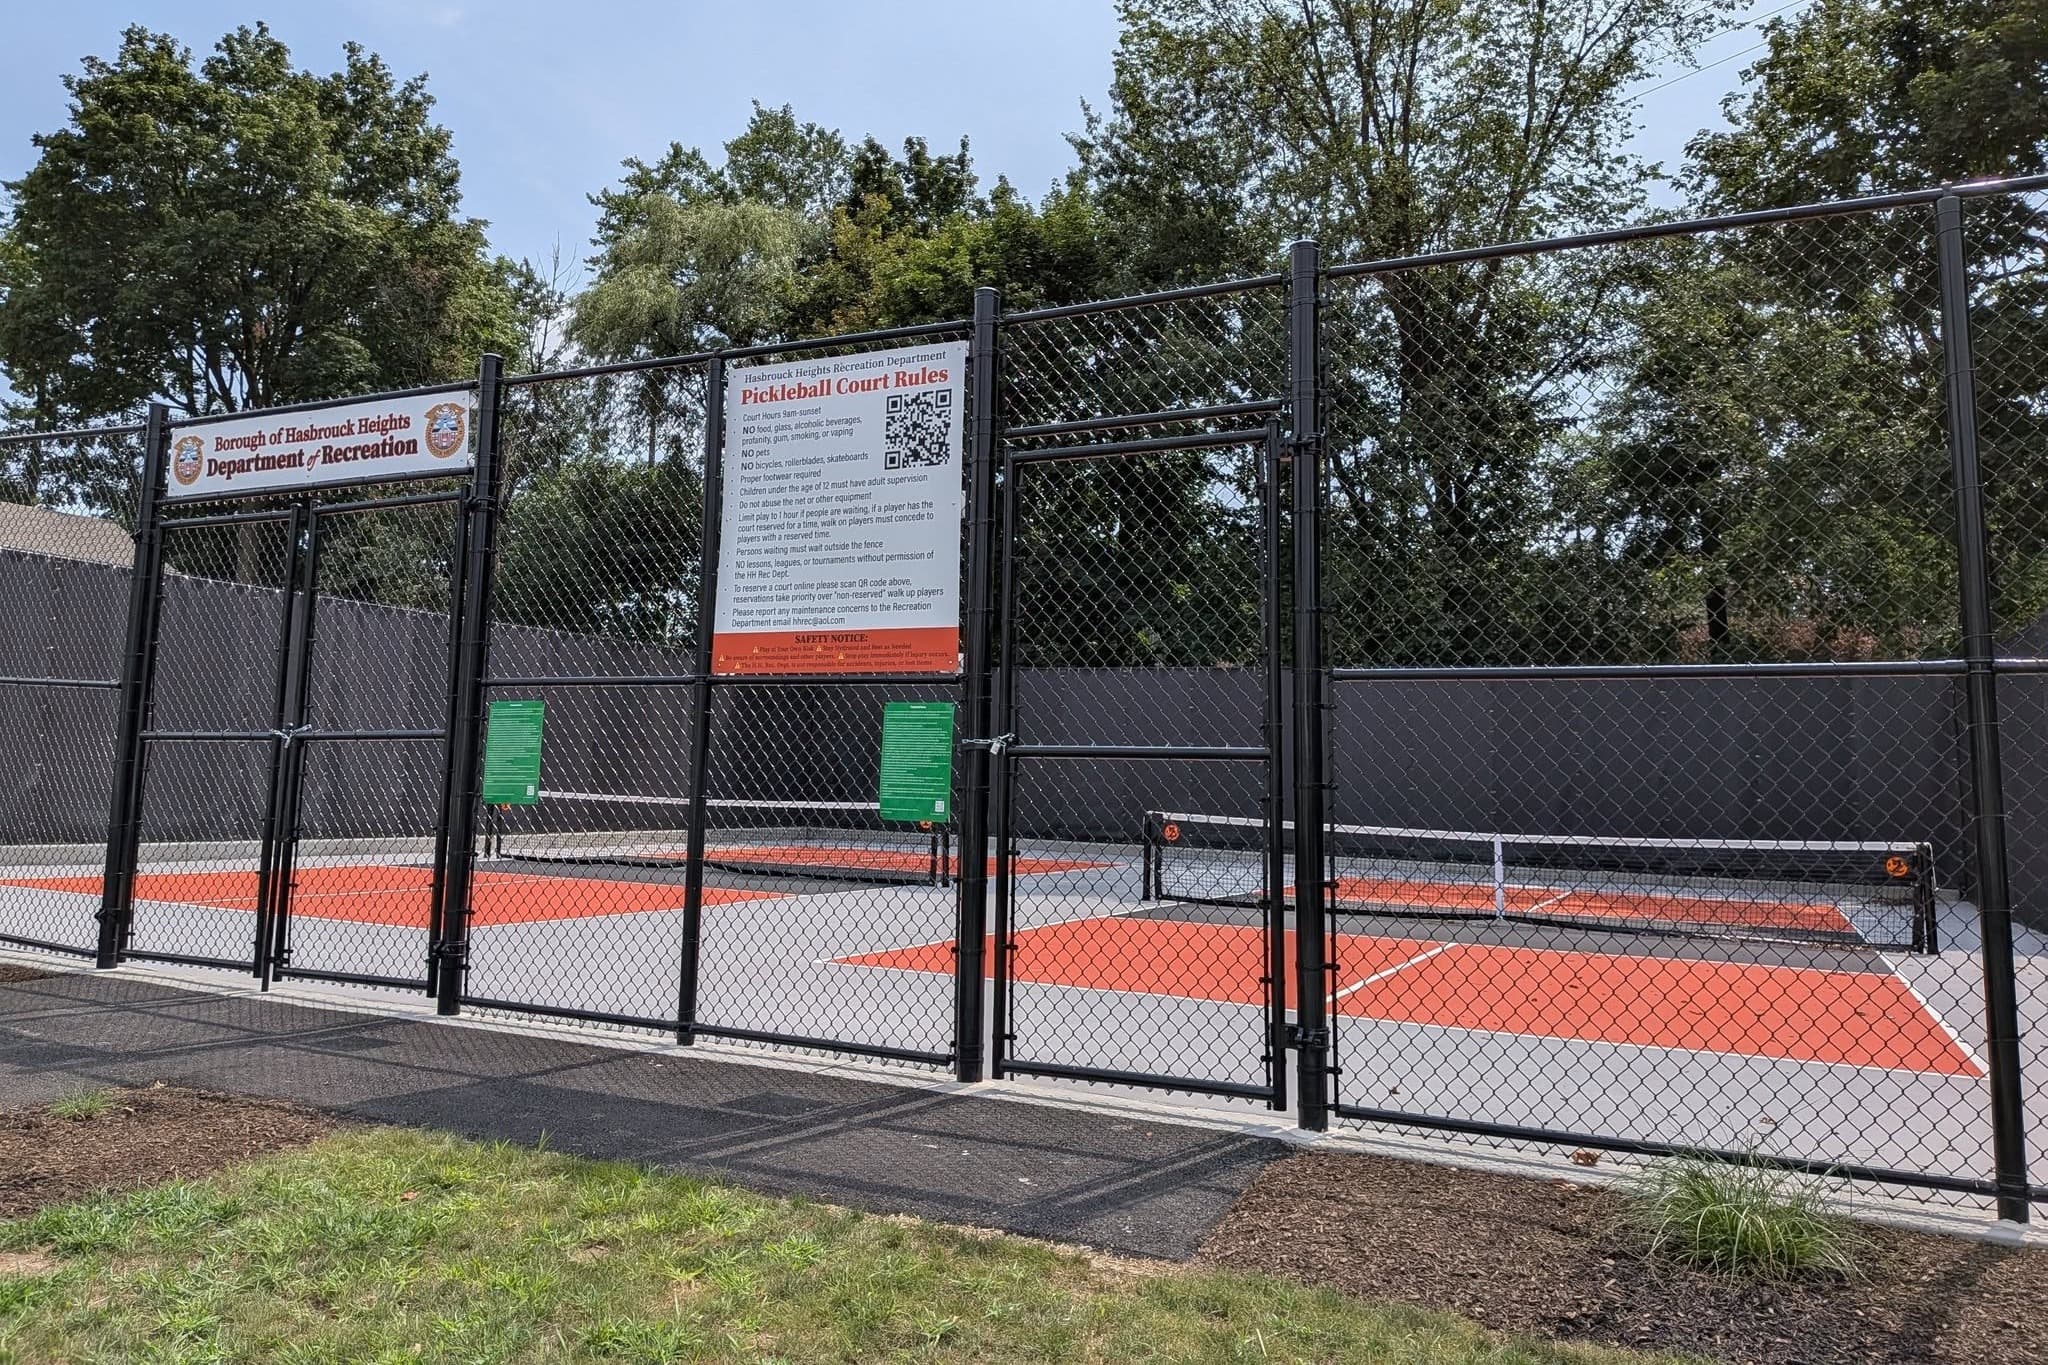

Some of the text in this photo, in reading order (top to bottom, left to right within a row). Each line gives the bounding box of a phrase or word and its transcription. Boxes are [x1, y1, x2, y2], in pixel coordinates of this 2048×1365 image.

[745, 350, 946, 383] Hasbrouck Heights Recreation Department
[741, 366, 948, 405] Pickleball Court Rules
[743, 406, 821, 422] Court Hours 9am-sunset
[215, 413, 410, 452] Borough of Hasbrouck Heights
[743, 417, 862, 434] NO food, glass, alcoholic beverages,
[742, 434, 772, 446] profanity,
[791, 430, 820, 440] smoking,
[831, 427, 853, 437] vaping
[207, 449, 304, 480] Department
[307, 449, 321, 471] of
[321, 436, 418, 464] Recreation
[741, 452, 868, 471] NO bicycles, rollerblades, skateboards
[742, 448, 770, 458] NO pets
[740, 473, 927, 496] Children under the age of 12 must have adult supervision
[741, 469, 821, 484] Proper footwear required
[740, 501, 747, 509] Do
[749, 499, 760, 508] not
[762, 499, 781, 507] abuse
[783, 497, 793, 506] the
[795, 496, 805, 505] net
[816, 495, 833, 503] other
[835, 492, 872, 504] equipment
[739, 512, 754, 521] Limit
[756, 512, 770, 522] play
[771, 511, 777, 519] to
[783, 510, 798, 518] hour
[800, 509, 804, 517] if
[806, 507, 828, 518] people
[872, 504, 876, 512] if
[884, 503, 905, 513] player
[907, 501, 919, 510] has
[922, 500, 933, 509] the
[738, 523, 754, 532] court
[756, 521, 784, 531] reserved
[787, 521, 795, 529] for
[821, 518, 836, 527] walk
[849, 516, 873, 527] players
[876, 514, 893, 523] must
[895, 512, 925, 522] concede
[927, 511, 934, 520] to
[737, 535, 760, 545] players
[762, 533, 776, 542] with
[784, 531, 812, 540] reserved
[736, 540, 883, 556] Persons waiting must wait outside the fence
[736, 560, 745, 568] NO
[747, 560, 772, 568] lessons,
[775, 558, 802, 568] leagues,
[812, 555, 855, 565] tournaments
[857, 553, 883, 562] without
[886, 552, 924, 563] permission
[927, 551, 934, 559] of
[735, 569, 789, 579] the HH Rec Dept.
[734, 584, 741, 592] To
[774, 582, 792, 591] court
[794, 581, 814, 590] online
[816, 581, 838, 591] please
[858, 579, 868, 587] QR
[870, 578, 887, 587] code
[889, 578, 912, 586] above,
[733, 594, 774, 603] reservations
[776, 593, 790, 601] take
[792, 592, 816, 603] priority
[888, 588, 904, 597] walk
[906, 590, 915, 598] up
[917, 587, 944, 597] players
[733, 608, 754, 616] Please
[756, 607, 776, 617] report
[778, 608, 790, 616] any
[792, 606, 835, 614] maintenance
[871, 604, 877, 612] to
[880, 603, 890, 611] the
[893, 602, 931, 611] Recreation
[732, 618, 771, 629] Department
[773, 617, 791, 626] email
[795, 634, 868, 644] SAFETY NOTICE:
